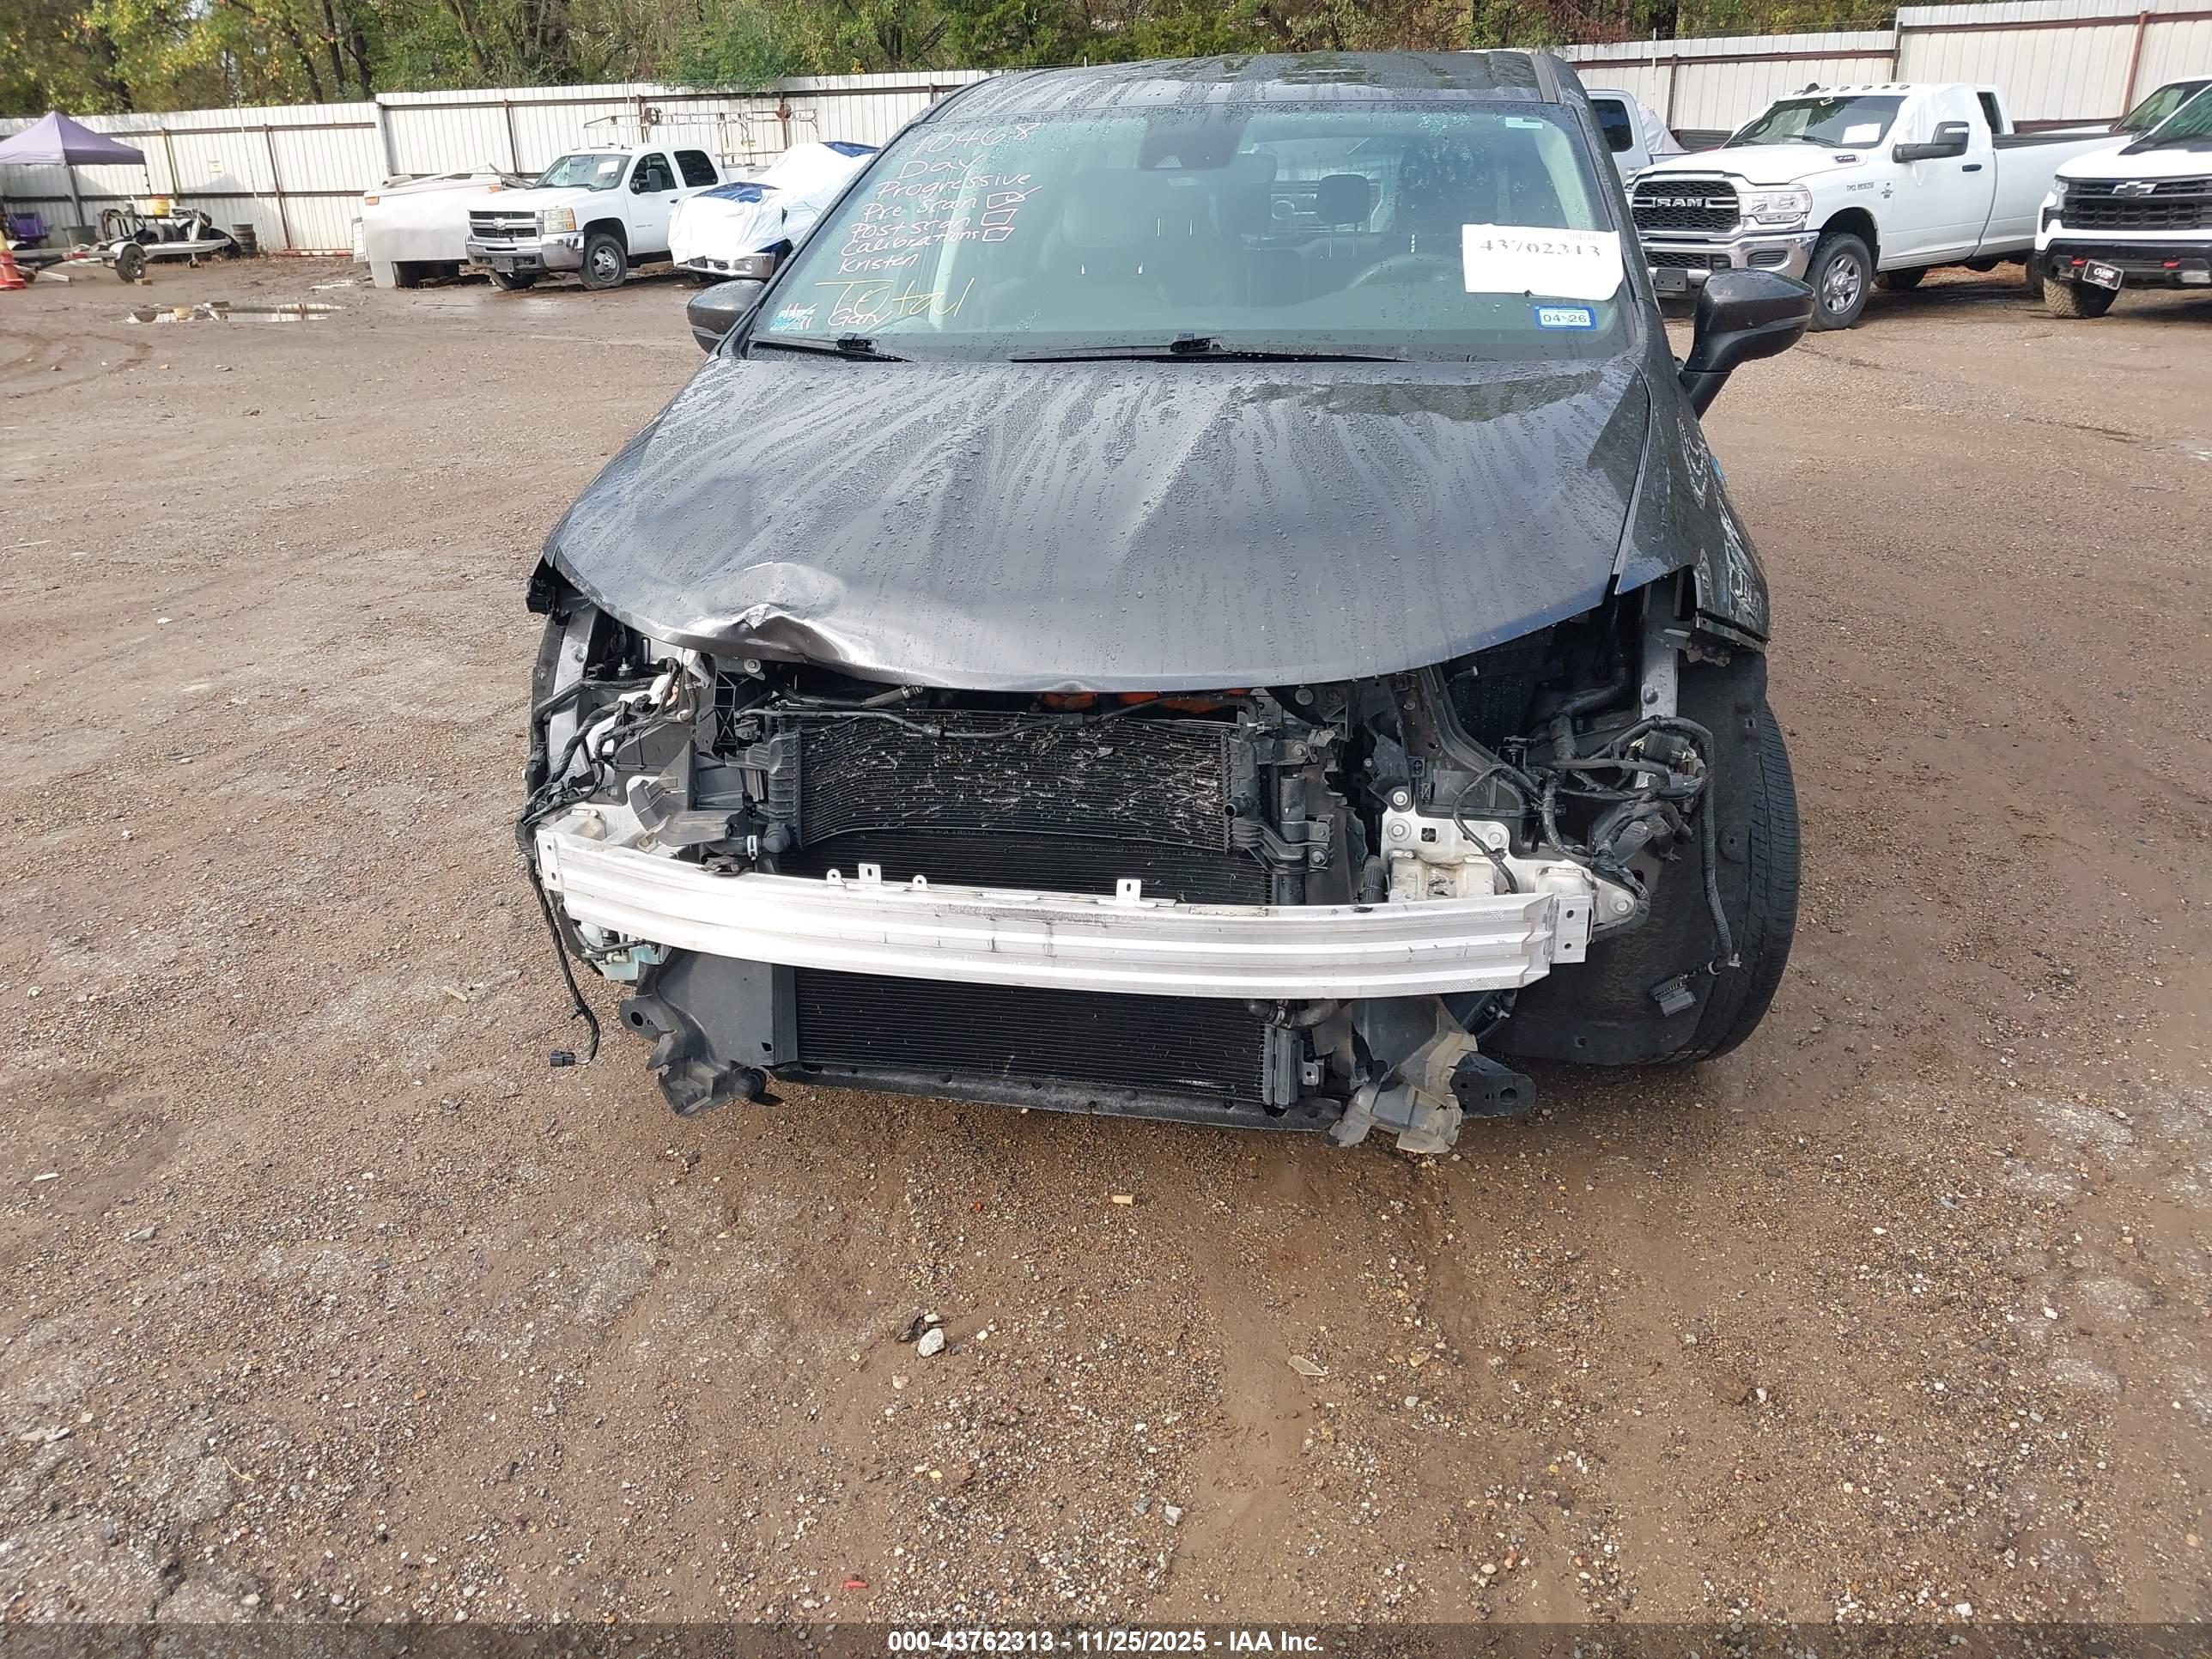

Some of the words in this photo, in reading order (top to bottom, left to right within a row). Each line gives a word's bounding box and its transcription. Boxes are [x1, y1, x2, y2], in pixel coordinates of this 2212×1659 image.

[911, 123, 1045, 157] 10468
[897, 155, 984, 179] Day
[876, 172, 1032, 200] Progressive
[862, 203, 902, 223] Pre
[916, 197, 977, 214] scan
[1656, 198, 1703, 207] RAM
